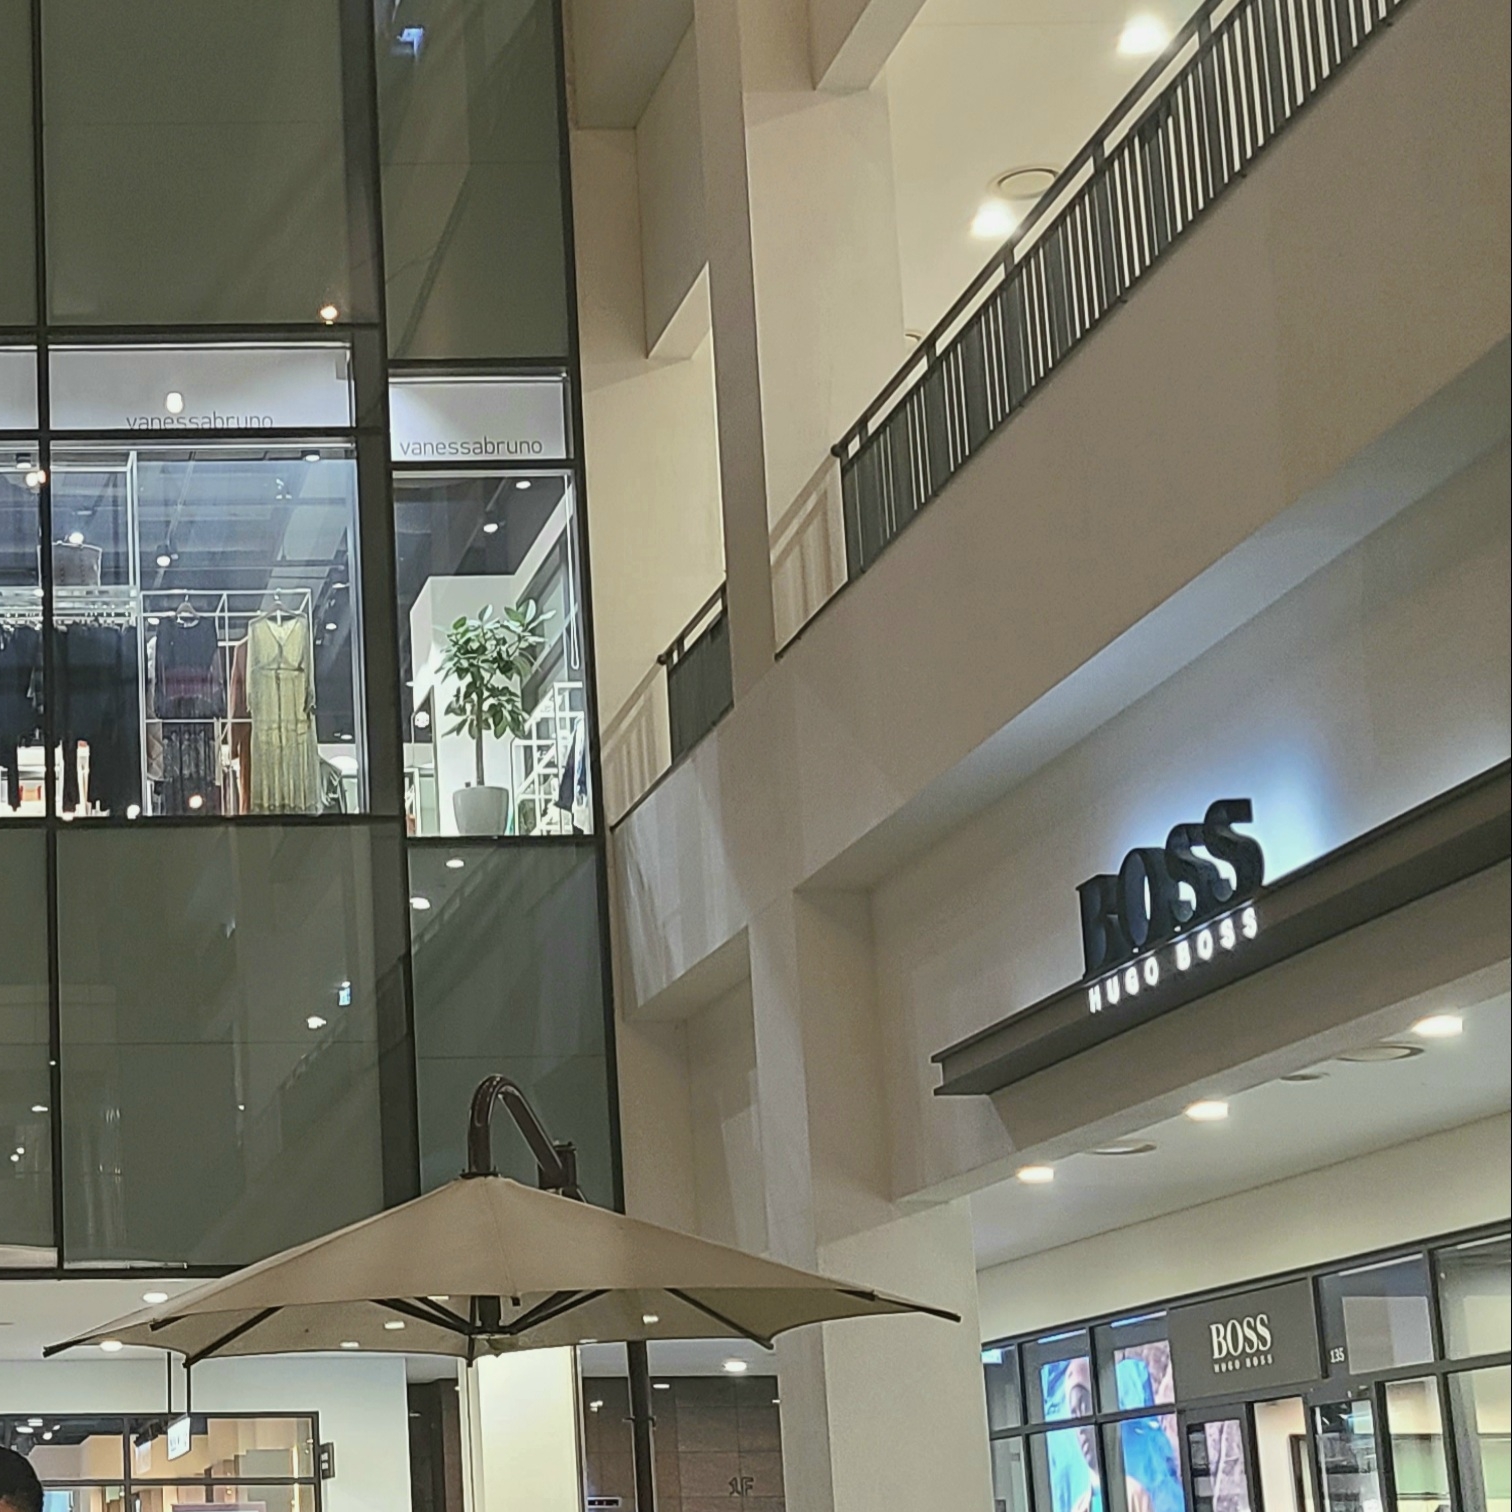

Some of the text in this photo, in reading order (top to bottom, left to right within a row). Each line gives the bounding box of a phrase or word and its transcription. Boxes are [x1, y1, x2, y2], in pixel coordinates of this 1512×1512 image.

[125, 411, 274, 429] vanessabruno
[399, 436, 543, 455] vanessabruno
[1076, 797, 1265, 980] BOSS
[1088, 906, 1258, 1014] HUGO BOSS
[1209, 1313, 1272, 1360] BOSS
[1329, 1347, 1346, 1364] 135
[728, 1476, 755, 1496] 1F
